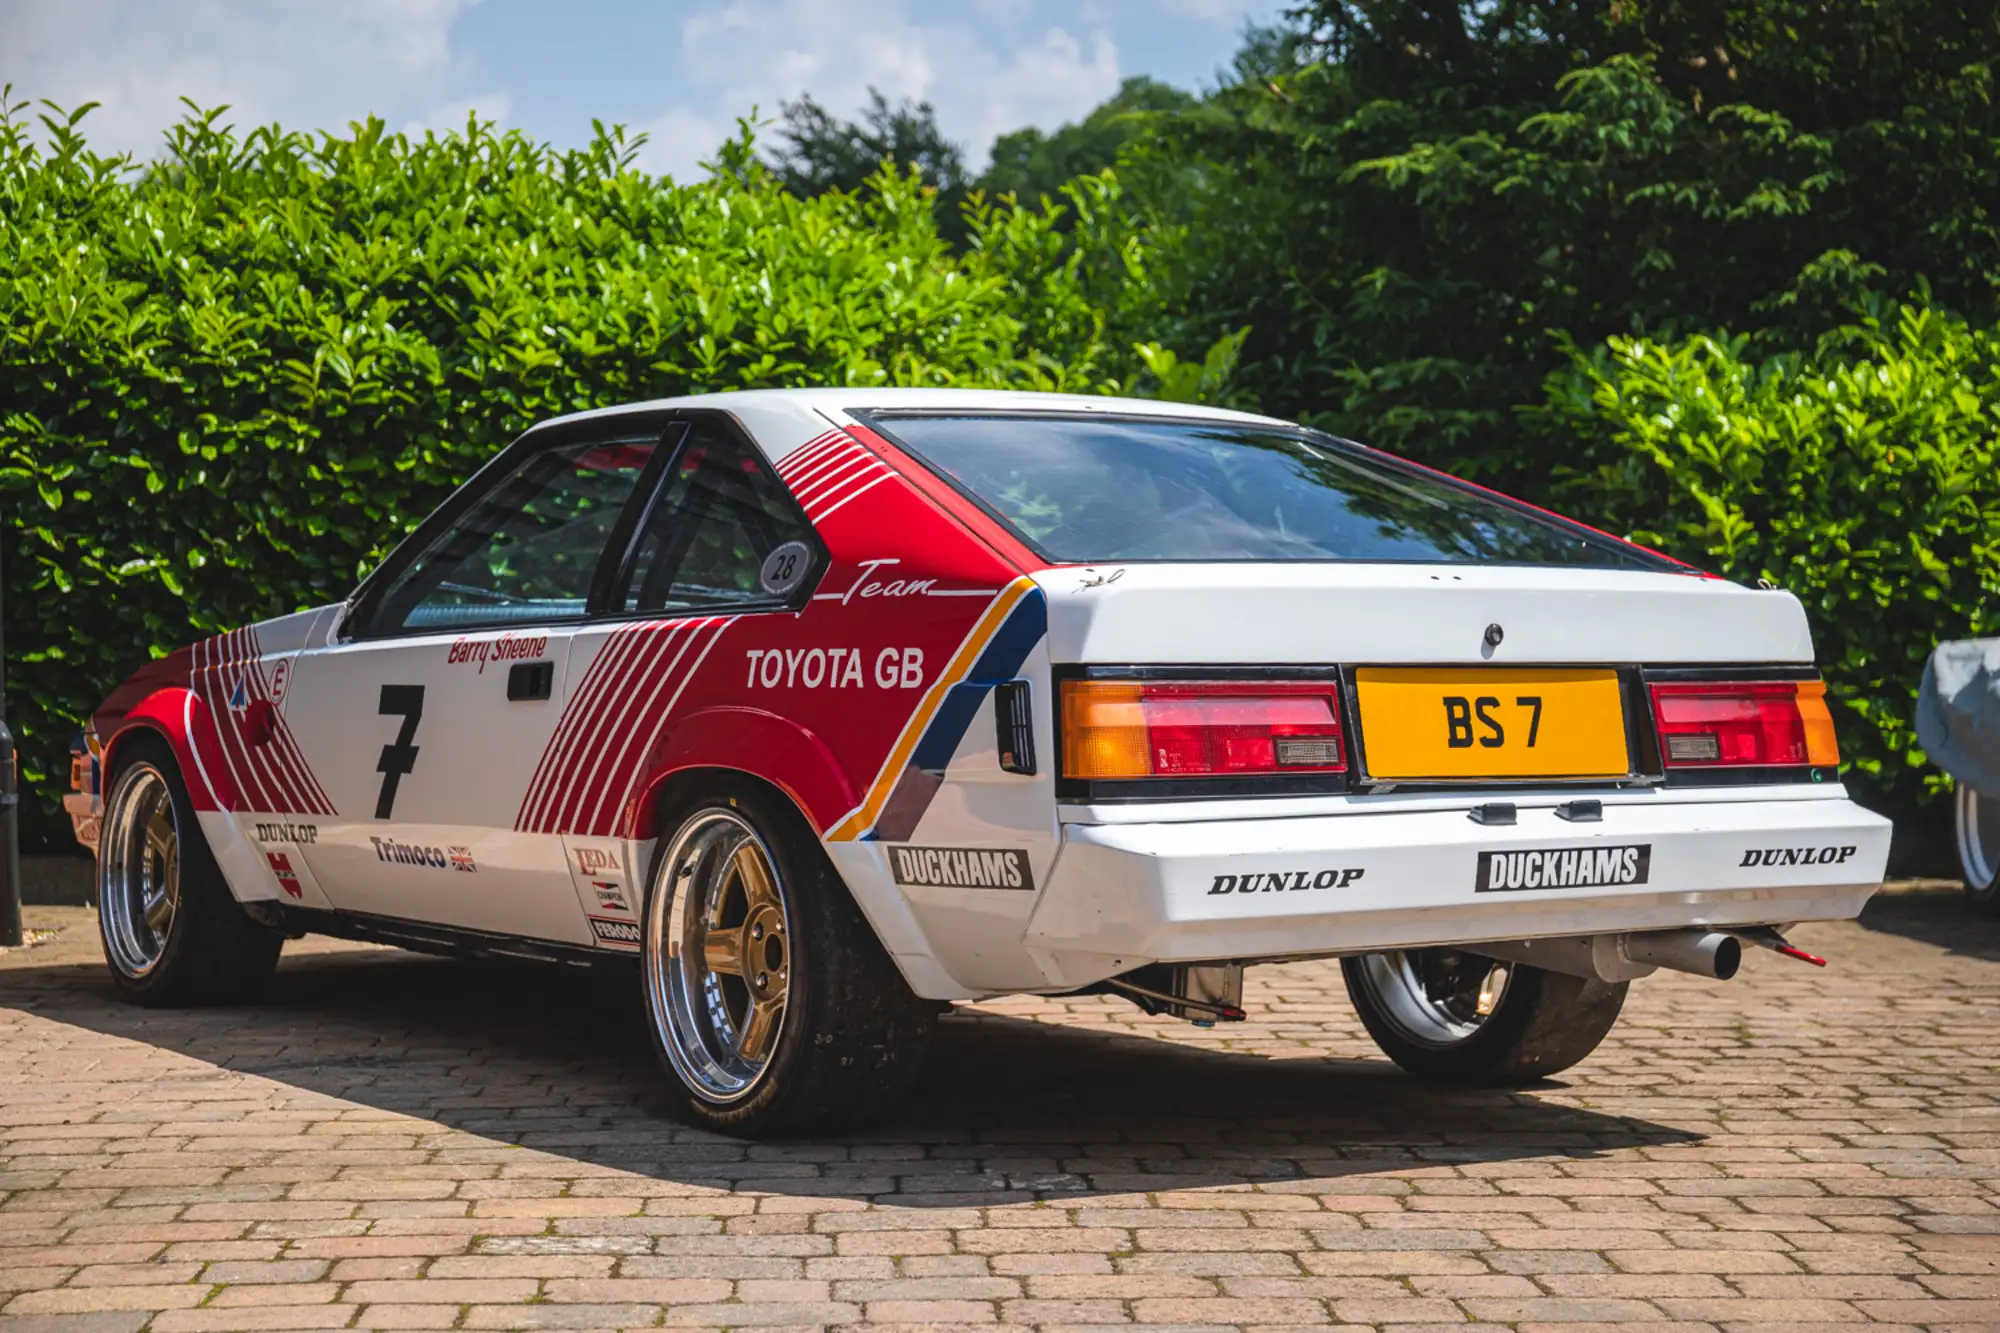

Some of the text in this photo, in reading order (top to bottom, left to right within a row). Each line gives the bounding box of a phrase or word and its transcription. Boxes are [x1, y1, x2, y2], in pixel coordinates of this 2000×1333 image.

[771, 554, 796, 580] 28
[842, 558, 938, 606] Team
[448, 632, 547, 674] Barry Sheene
[746, 647, 924, 689] TOYOTA GB
[273, 668, 284, 696] E
[1443, 697, 1542, 748] BS 7
[374, 684, 425, 819] 7
[256, 824, 318, 844] DUNLOP
[369, 836, 446, 868] Trimoco
[573, 848, 620, 876] LEDA
[898, 848, 1022, 888] DUCKHAMS
[1488, 848, 1637, 890] DUCKHAMS
[1739, 846, 1857, 867] DUNLOP
[1207, 868, 1365, 895] DUNLOP
